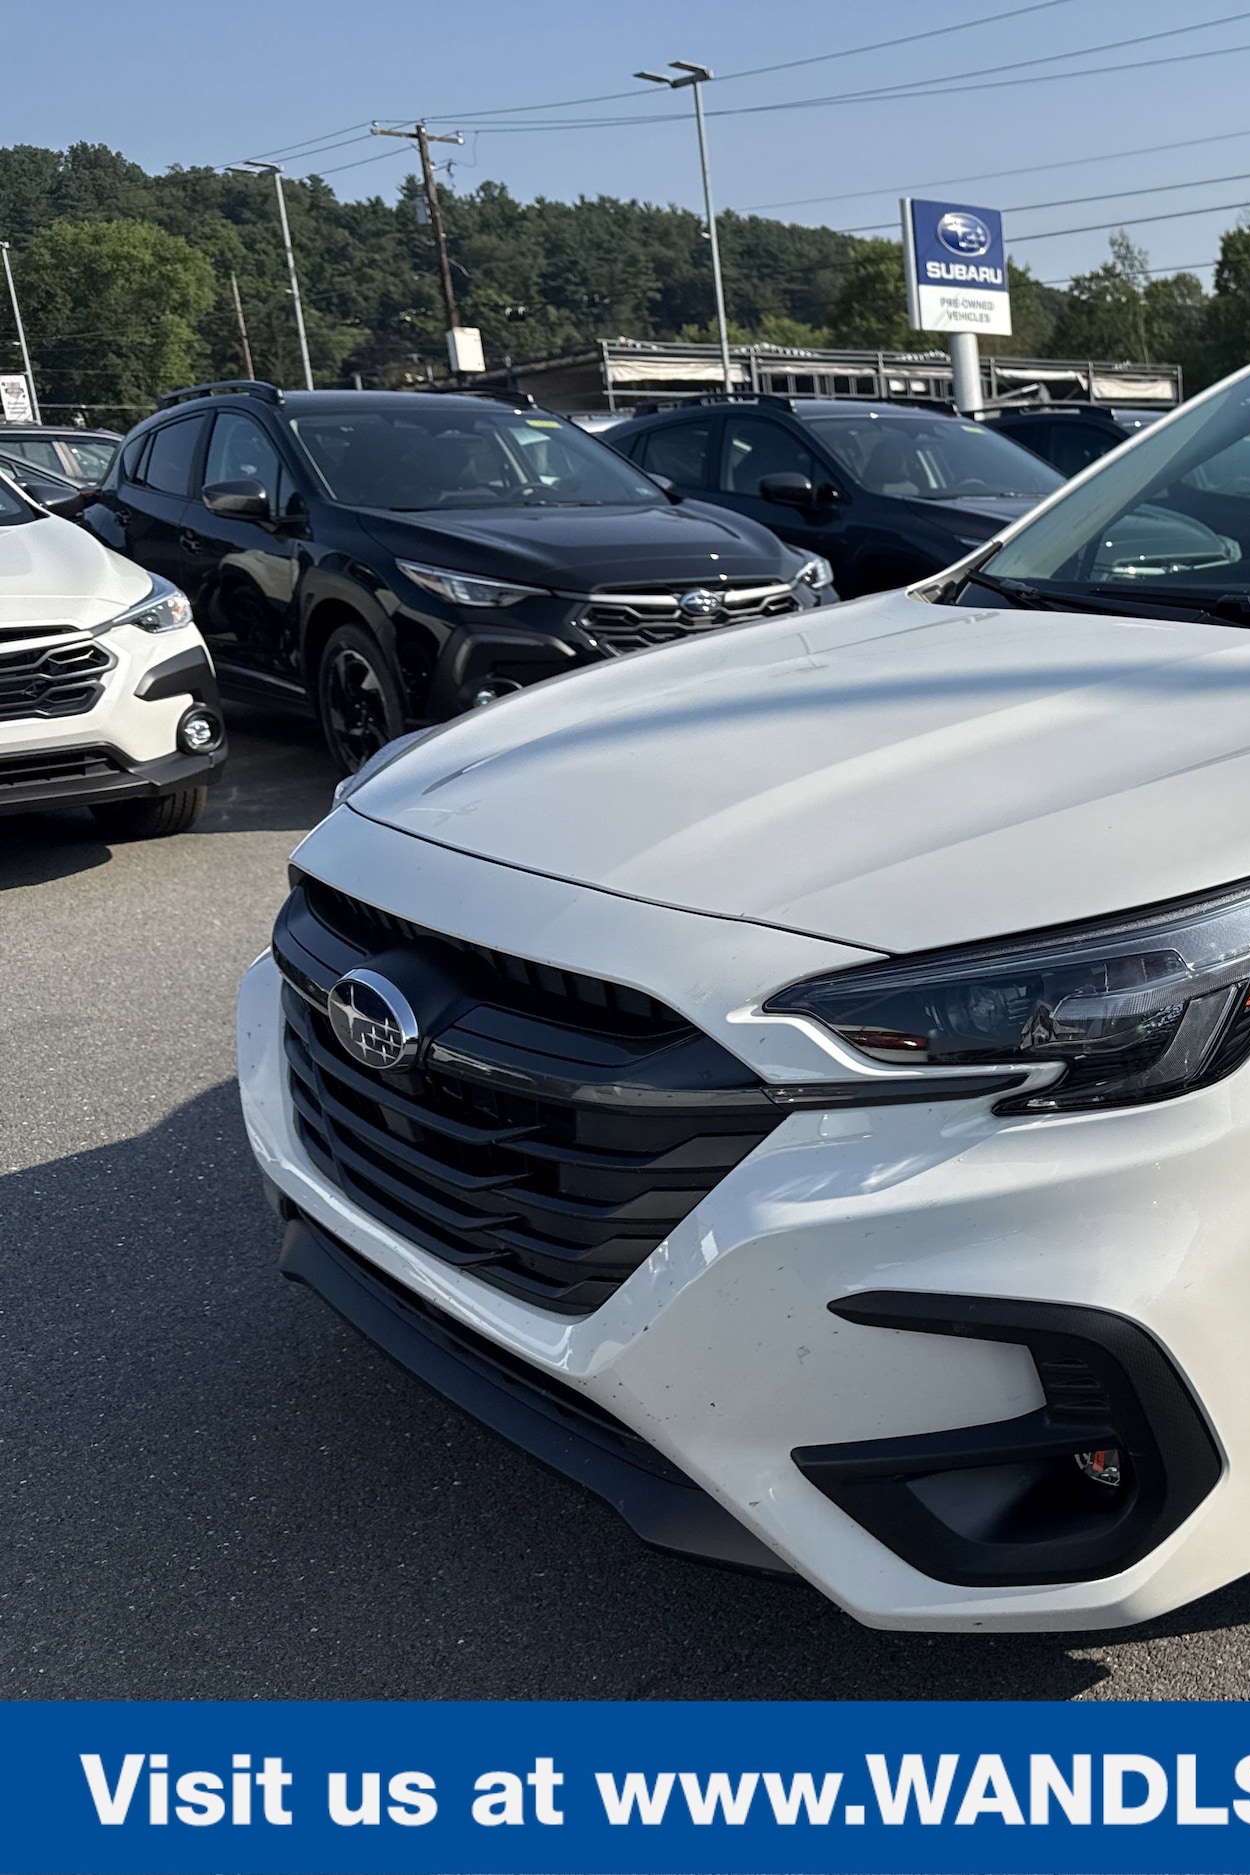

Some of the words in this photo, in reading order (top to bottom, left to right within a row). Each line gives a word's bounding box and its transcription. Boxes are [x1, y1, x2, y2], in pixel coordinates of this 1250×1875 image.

[926, 261, 1003, 284] SUBARU
[940, 298, 995, 311] PRE-OWNED
[946, 311, 991, 323] VEHICLES
